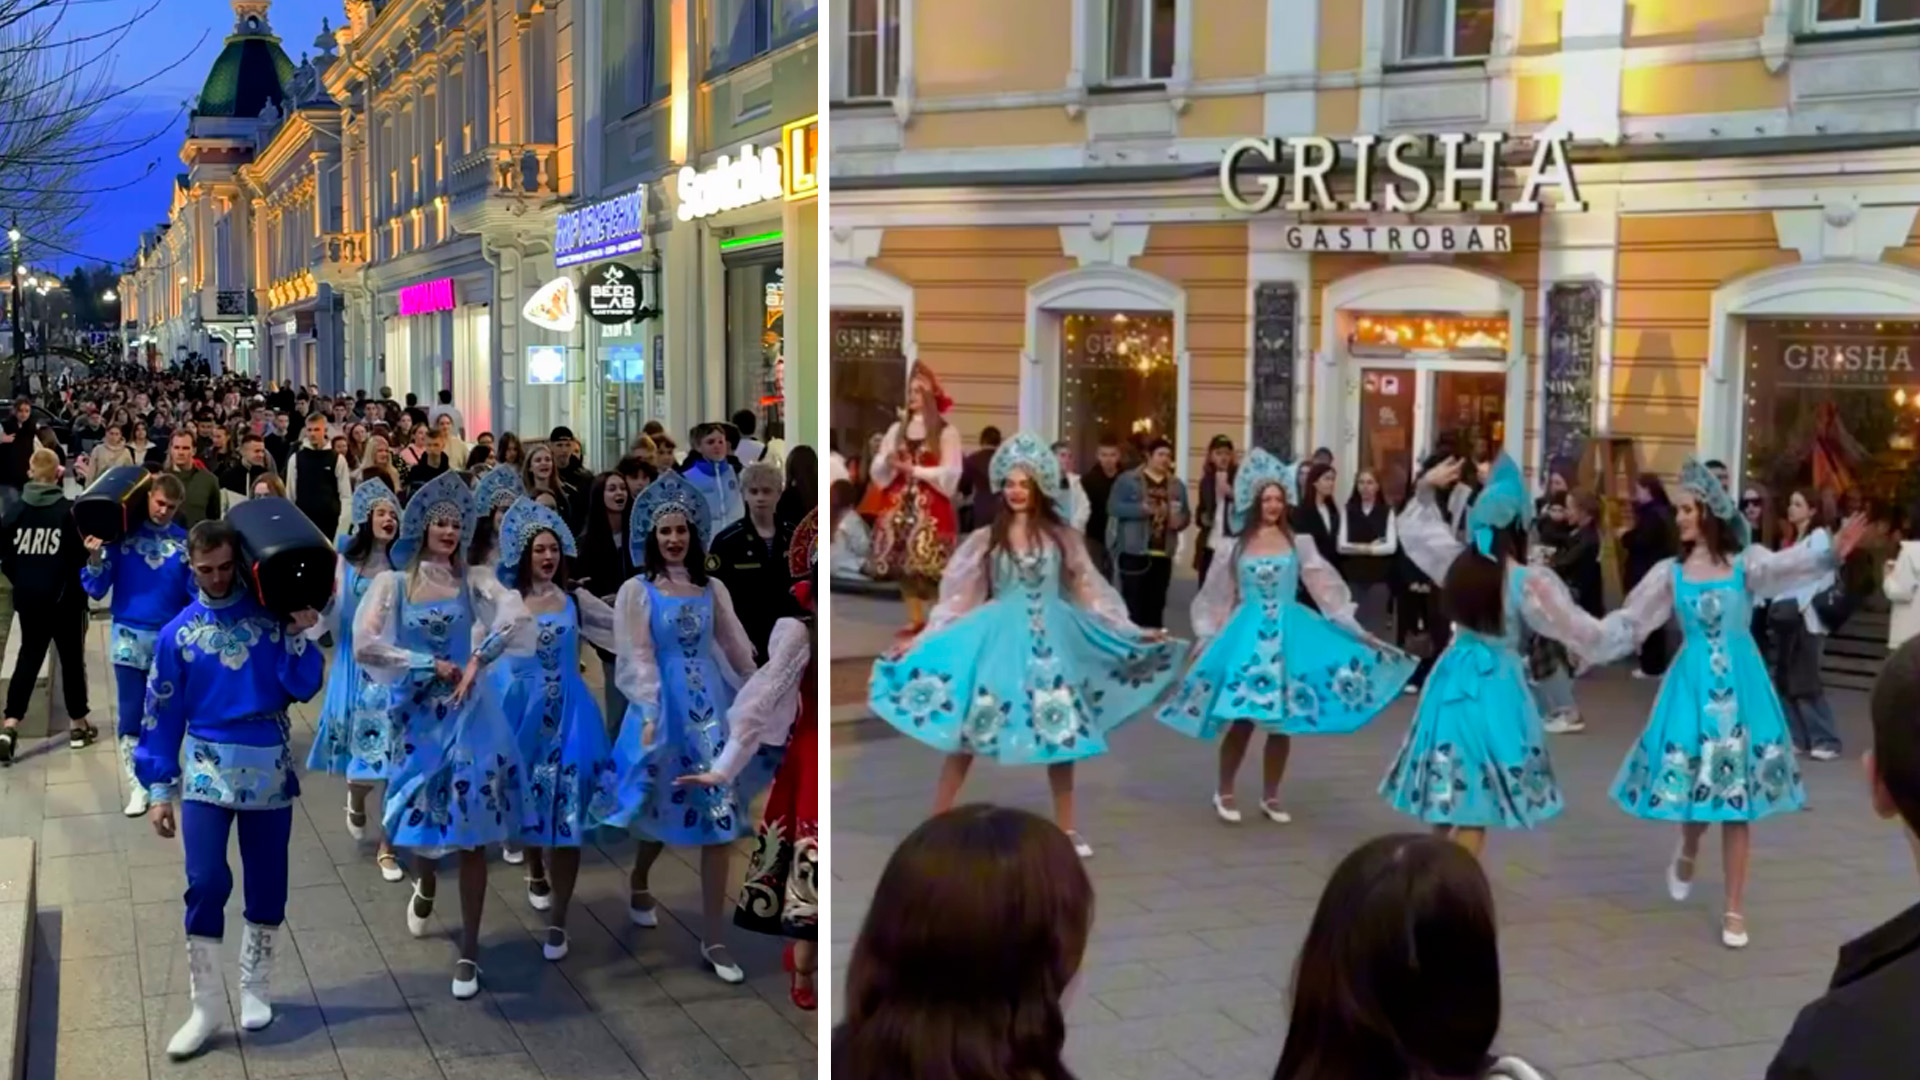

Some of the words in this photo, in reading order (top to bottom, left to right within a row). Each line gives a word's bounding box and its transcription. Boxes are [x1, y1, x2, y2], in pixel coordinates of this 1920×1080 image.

[1220, 132, 1588, 212] GRISHA
[1287, 227, 1510, 250] GASTROBAR
[591, 285, 634, 297] BEER
[591, 297, 635, 308] LAB
[1784, 344, 1914, 371] GRISHA
[13, 528, 62, 555] PARIS
